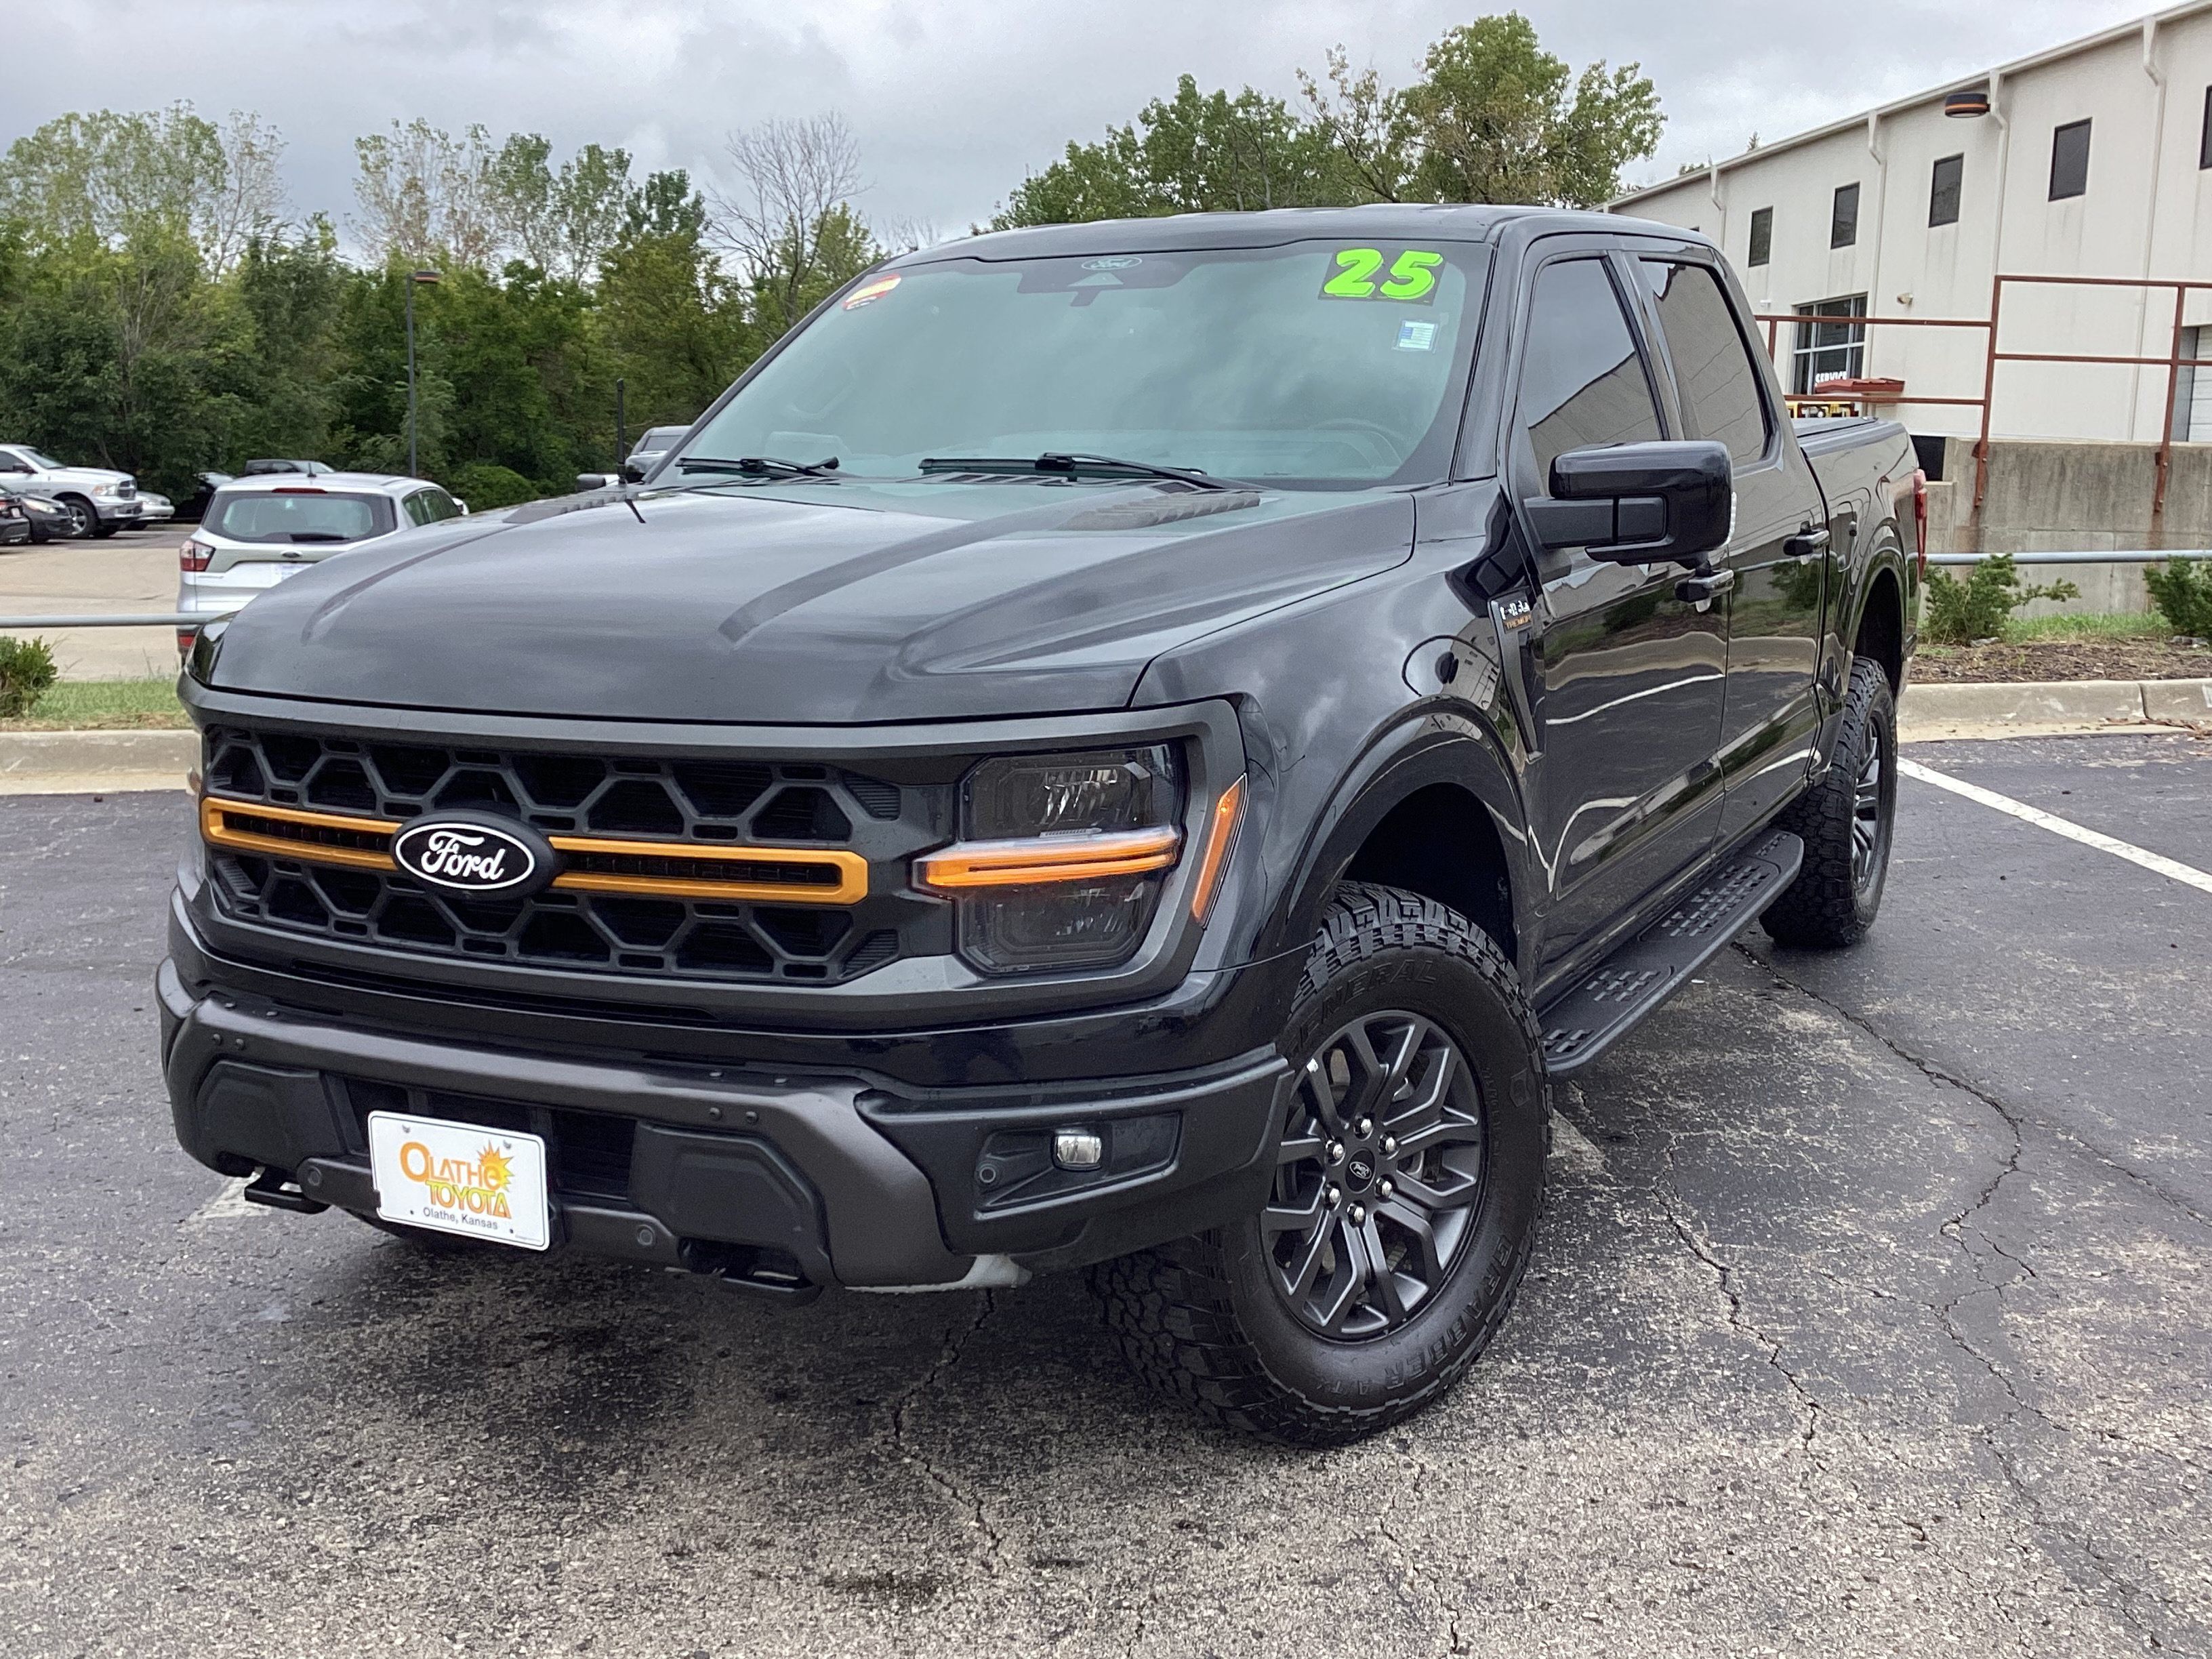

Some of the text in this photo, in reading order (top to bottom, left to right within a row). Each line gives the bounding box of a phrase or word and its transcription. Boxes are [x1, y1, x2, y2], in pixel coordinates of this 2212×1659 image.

[1324, 248, 1443, 300] 25
[421, 831, 506, 880] Ford
[422, 1206, 499, 1230] Olathe, Kansas
[425, 1180, 512, 1219] TOYOTA
